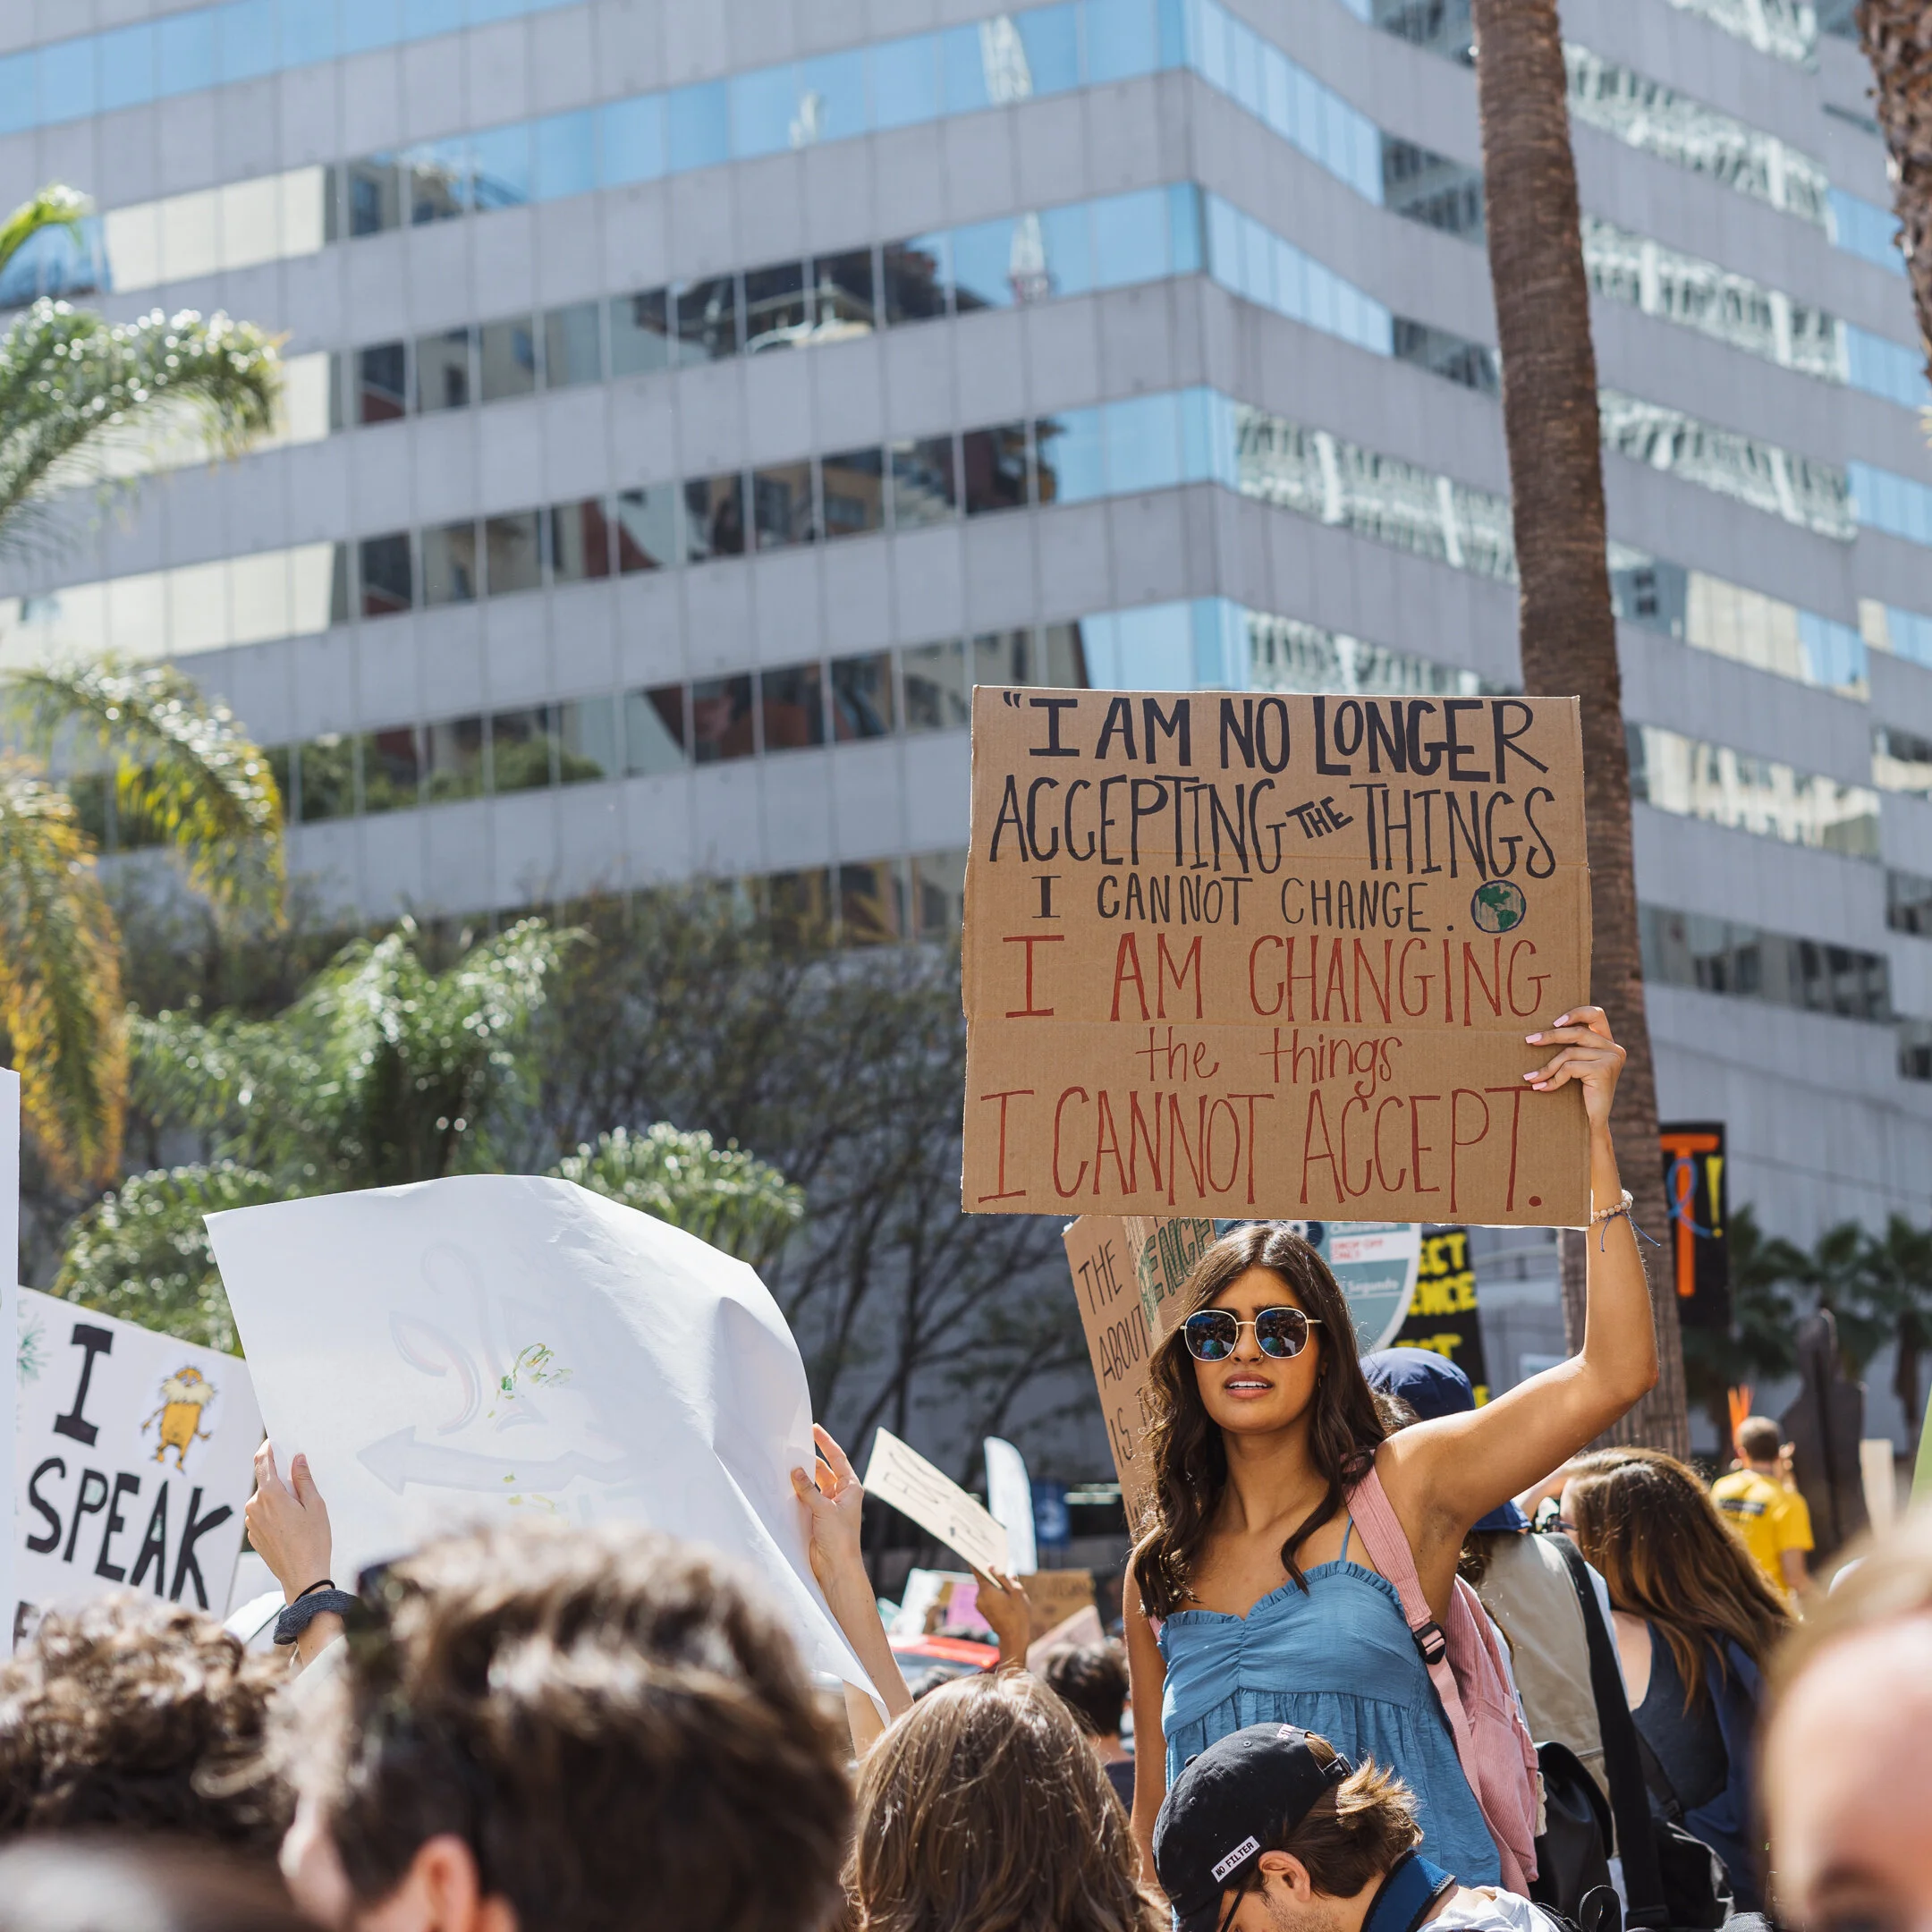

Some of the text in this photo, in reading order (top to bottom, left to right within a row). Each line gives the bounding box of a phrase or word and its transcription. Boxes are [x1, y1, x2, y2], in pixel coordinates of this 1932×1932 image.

[1095, 697, 1192, 767] AM
[1219, 698, 1290, 775] NO
[1312, 695, 1549, 784] LONGER
[988, 774, 1556, 879] ACCEPTING THE THINGS
[1030, 876, 1062, 919] I
[1097, 873, 1254, 926] CANNOT
[1002, 932, 1552, 1027] I AM CHANGING
[1135, 1026, 1403, 1100] the things
[978, 1086, 1544, 1214] I CANNOT ACCEPT.
[1078, 1239, 1123, 1315] THE
[53, 1323, 114, 1446] I
[1098, 1304, 1149, 1390] ABOUT
[1110, 1407, 1133, 1469] IS
[25, 1456, 233, 1610] SPEAK
[1215, 1842, 1255, 1877] NO FILTER
